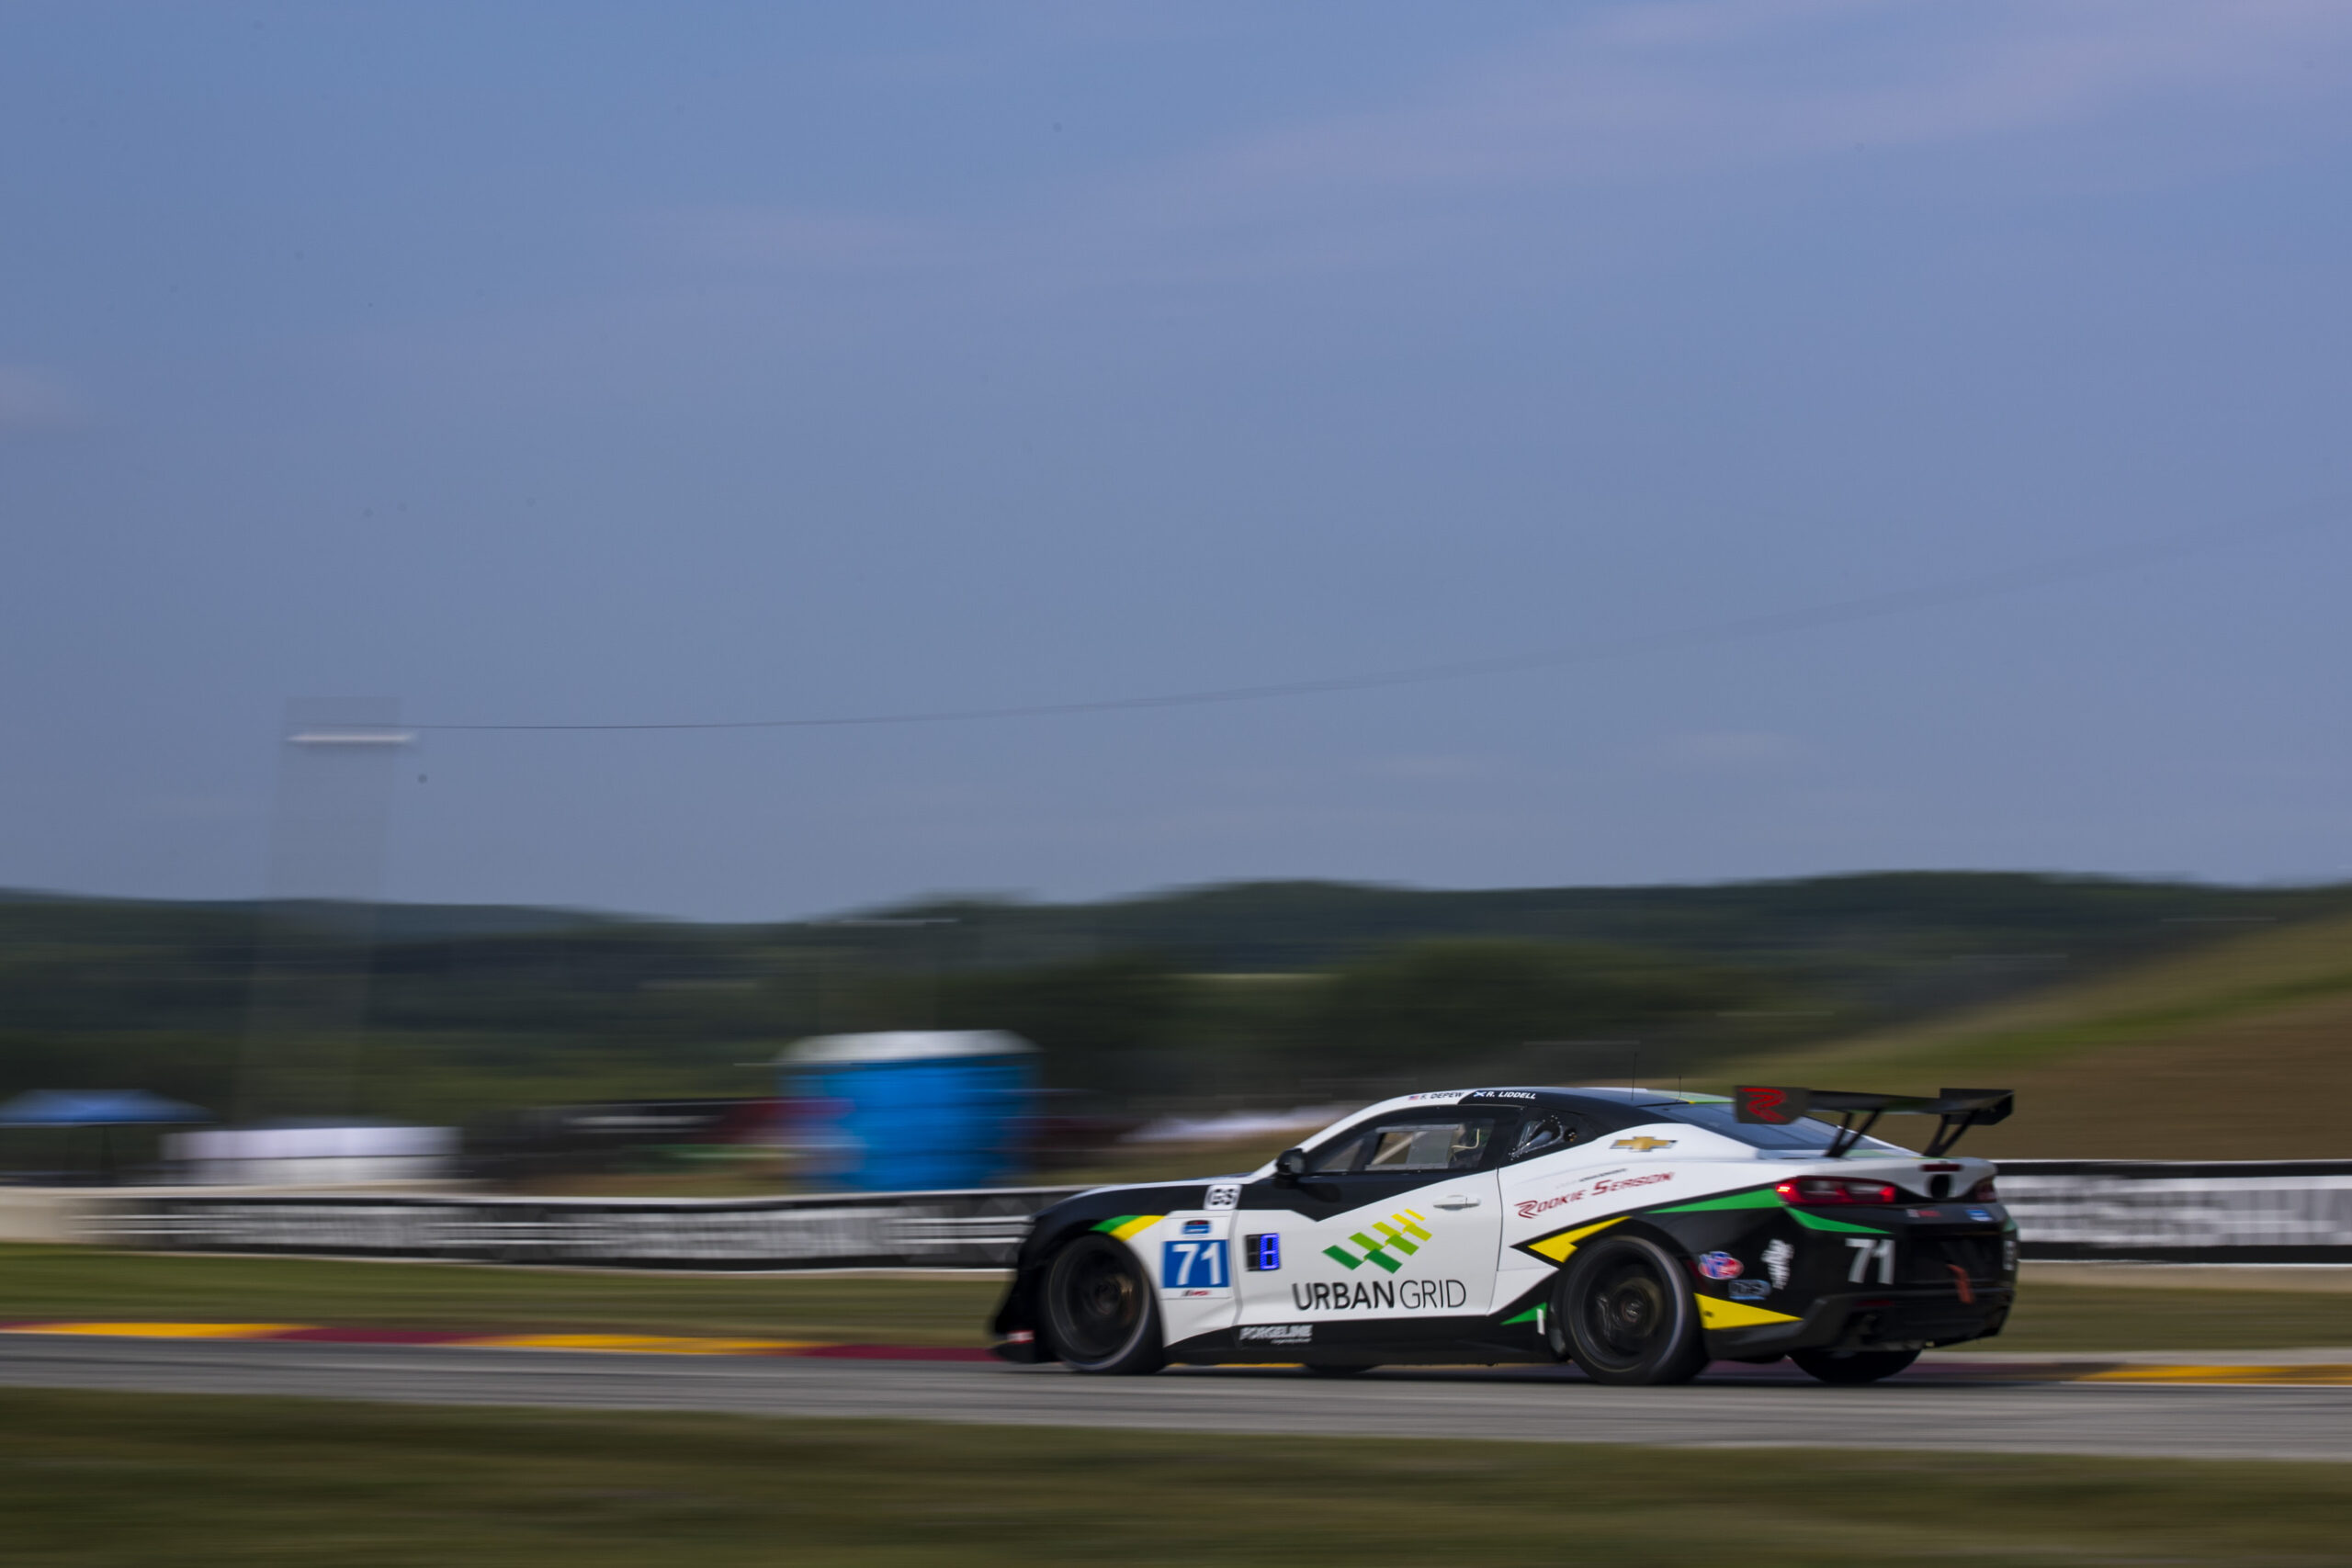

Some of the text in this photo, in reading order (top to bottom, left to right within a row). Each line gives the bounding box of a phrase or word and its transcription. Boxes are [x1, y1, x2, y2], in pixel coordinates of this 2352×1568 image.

[1430, 1091, 1464, 1100] DEPEW
[1498, 1091, 1536, 1100] LIDDELL
[1207, 1188, 1237, 1206] GS
[1170, 1242, 1223, 1286] 71
[1845, 1238, 1895, 1284] 71
[1292, 1280, 1467, 1310] URBAN GRID
